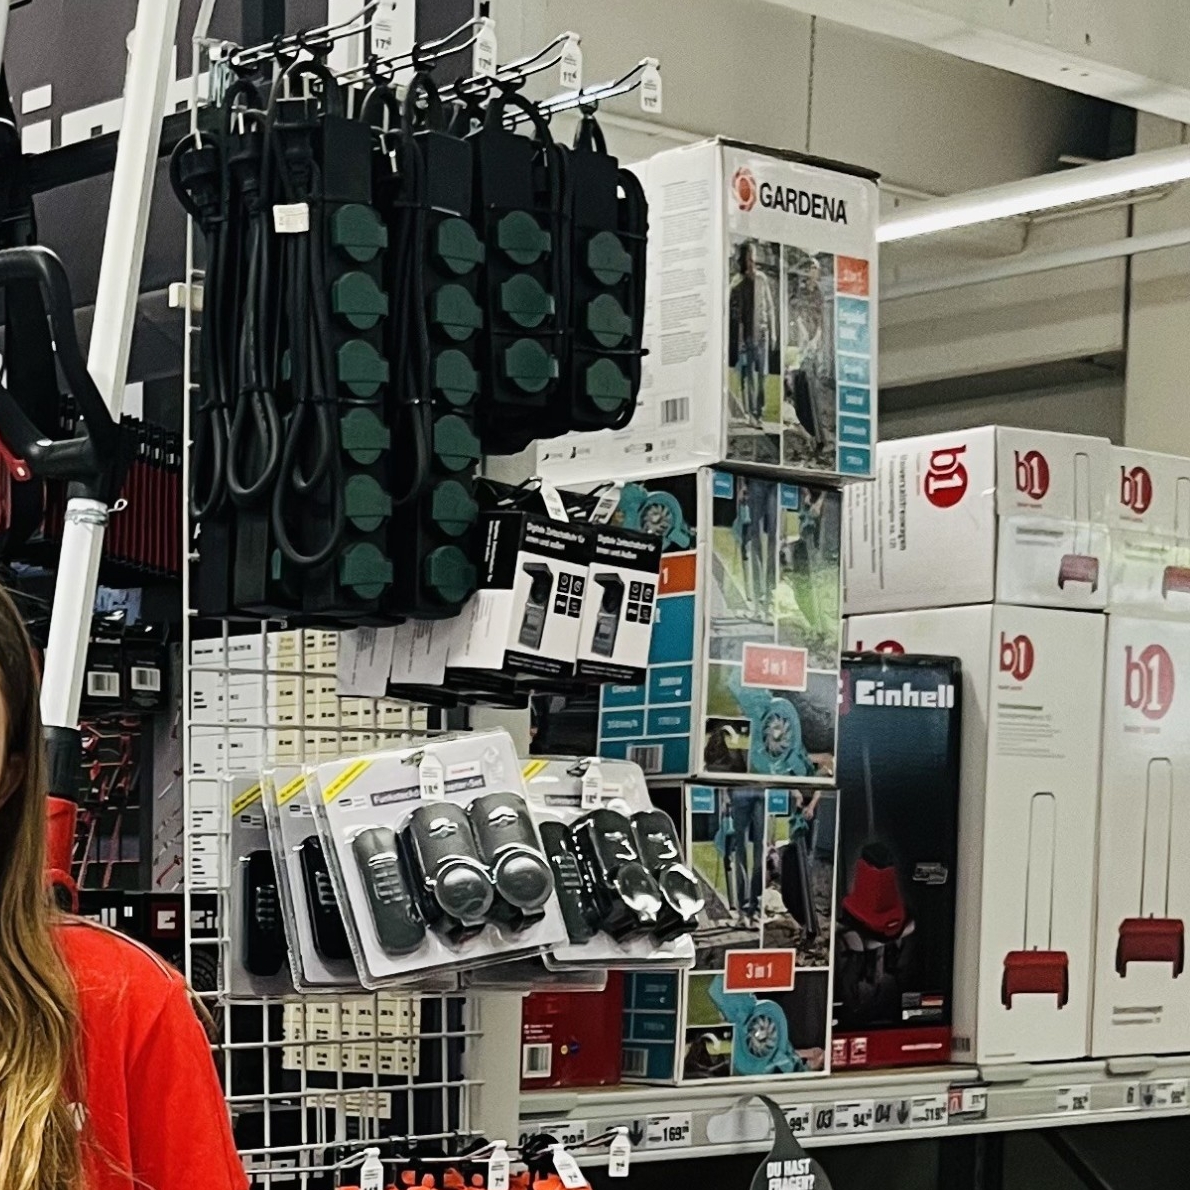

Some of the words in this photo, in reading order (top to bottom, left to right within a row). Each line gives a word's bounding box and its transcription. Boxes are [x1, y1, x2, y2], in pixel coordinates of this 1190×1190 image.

[759, 181, 849, 225] GARDENA
[1014, 449, 1050, 500] b1
[1120, 466, 1153, 514] b1
[999, 631, 1035, 681] b1
[855, 679, 955, 709] Einhell
[1124, 644, 1175, 720] b1
[767, 1161, 782, 1178] DU
[784, 1158, 810, 1176] HAST
